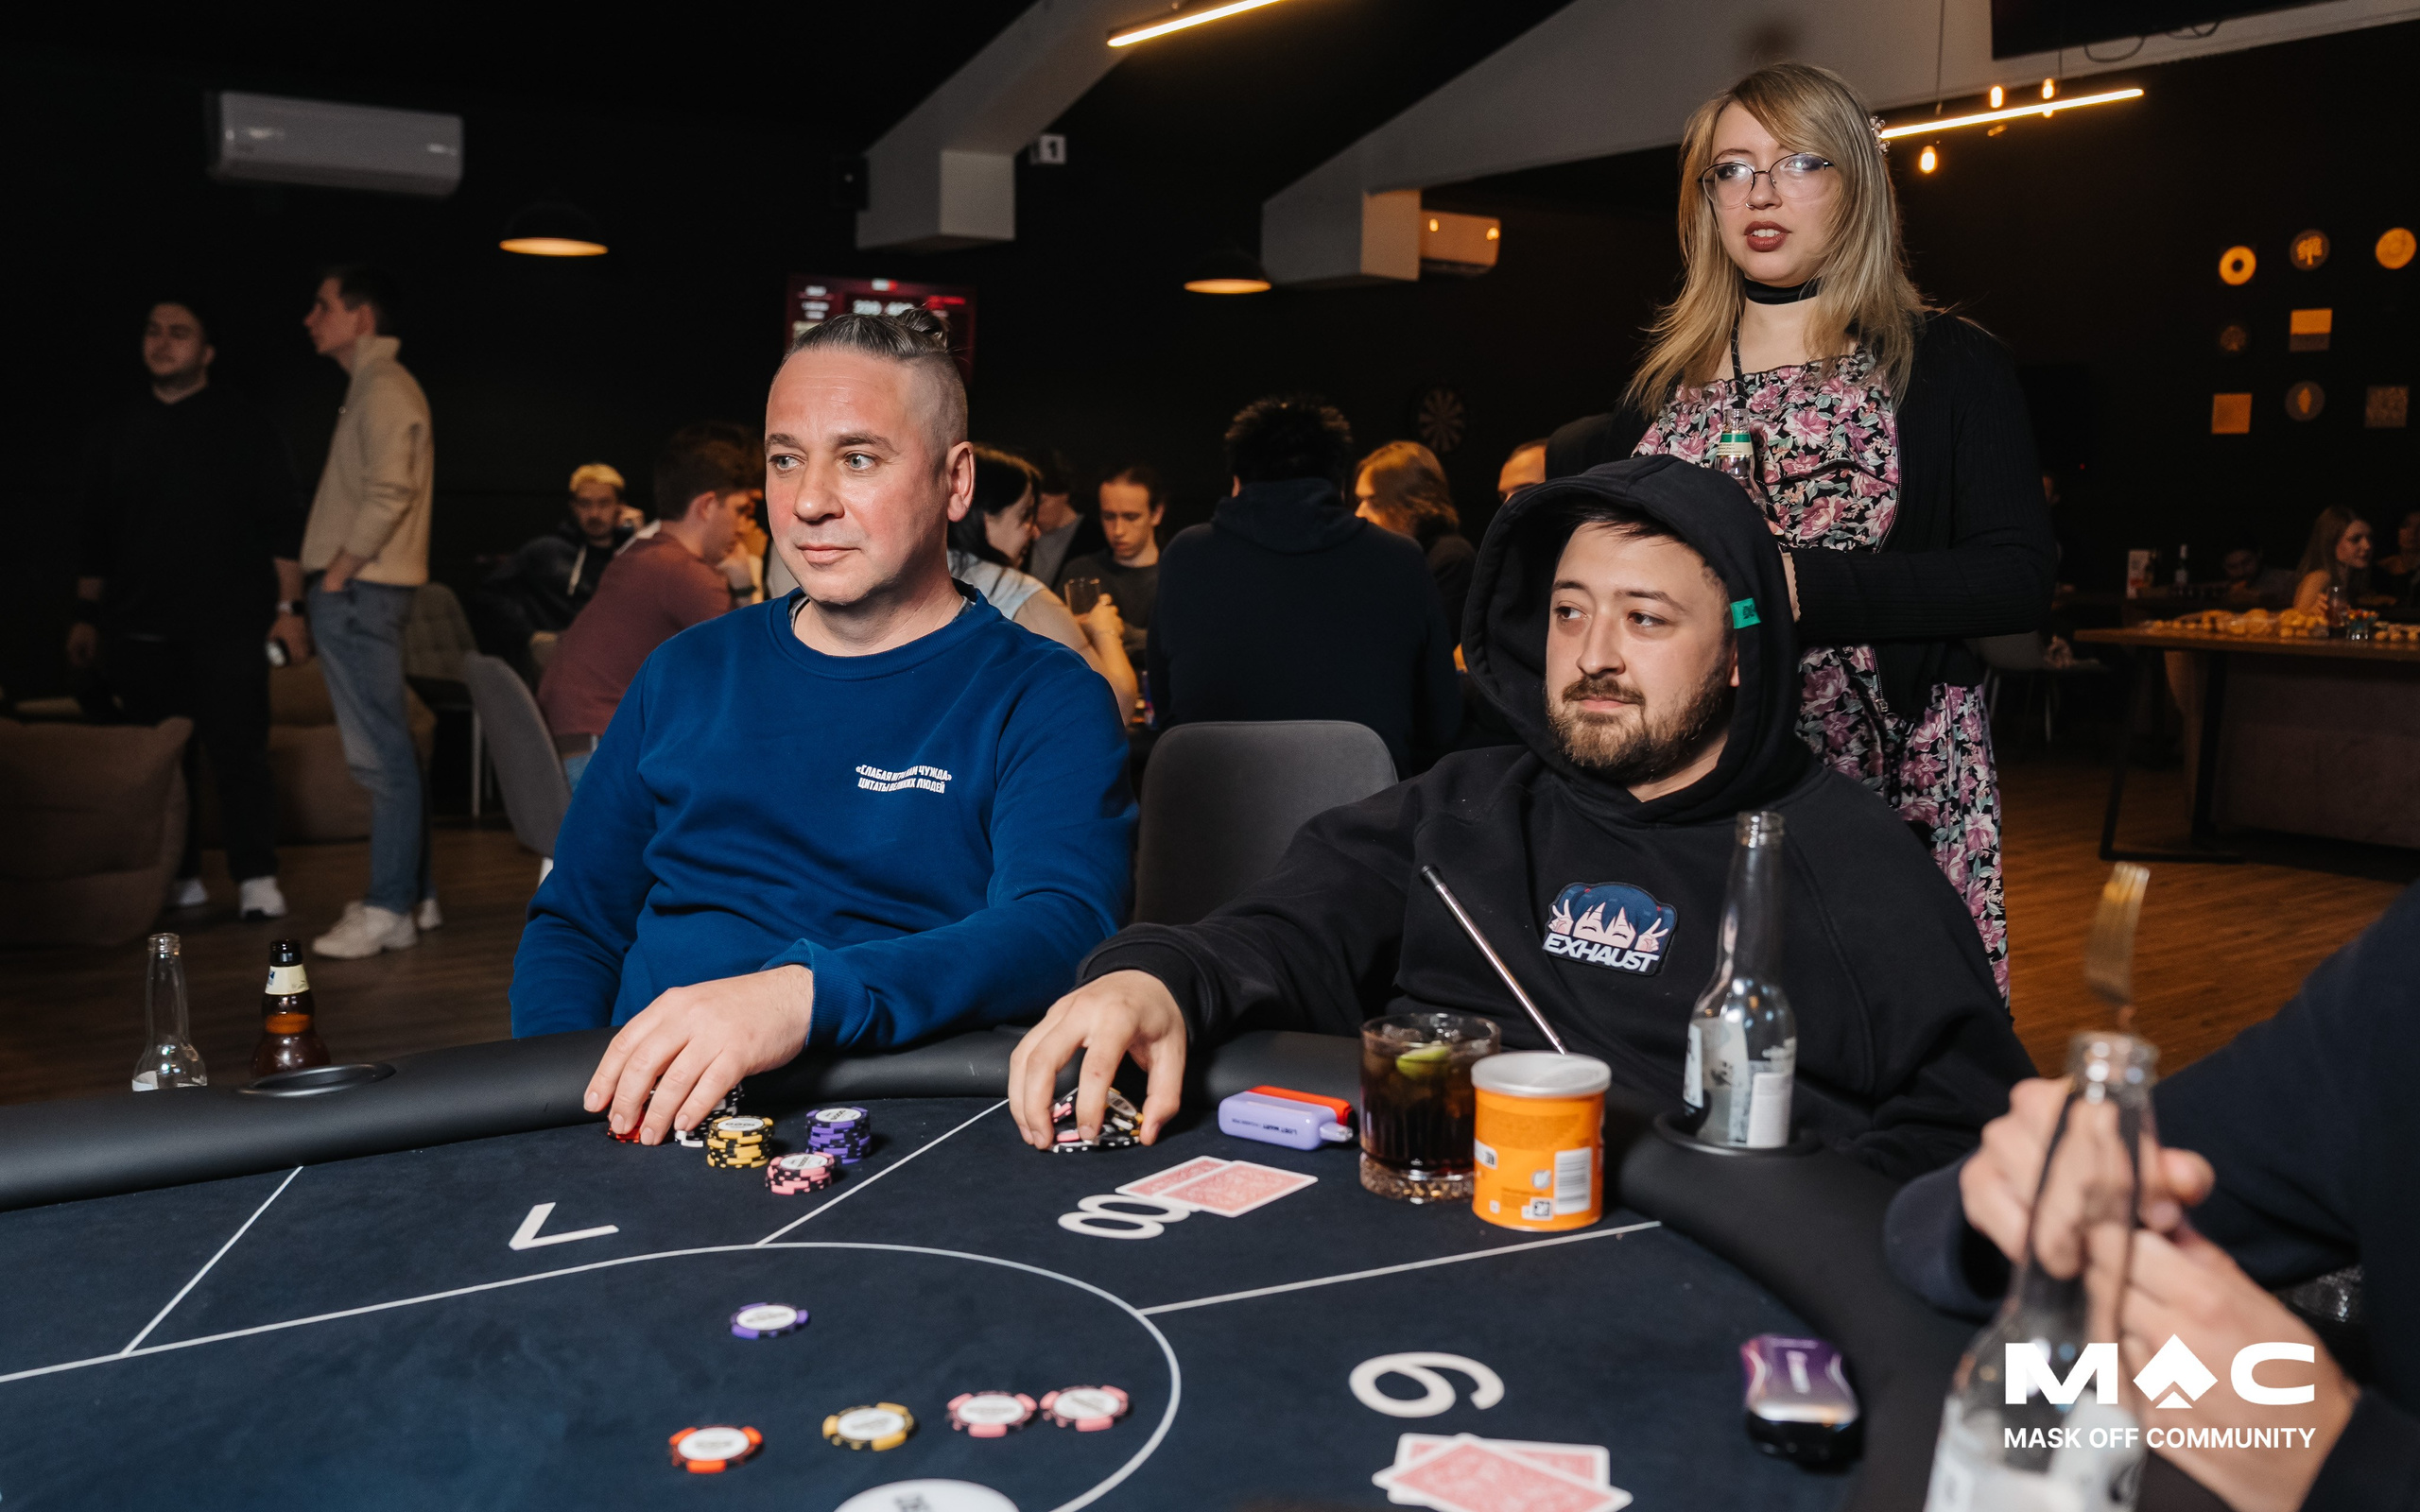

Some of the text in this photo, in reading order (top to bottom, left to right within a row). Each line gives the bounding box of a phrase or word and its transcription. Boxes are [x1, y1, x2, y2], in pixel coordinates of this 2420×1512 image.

[857, 777, 889, 792] ЦИТАТЫ
[916, 778, 946, 794] ЛЮДЕЙ
[1542, 932, 1660, 972] EXHAUST
[1058, 1194, 1190, 1239] 8
